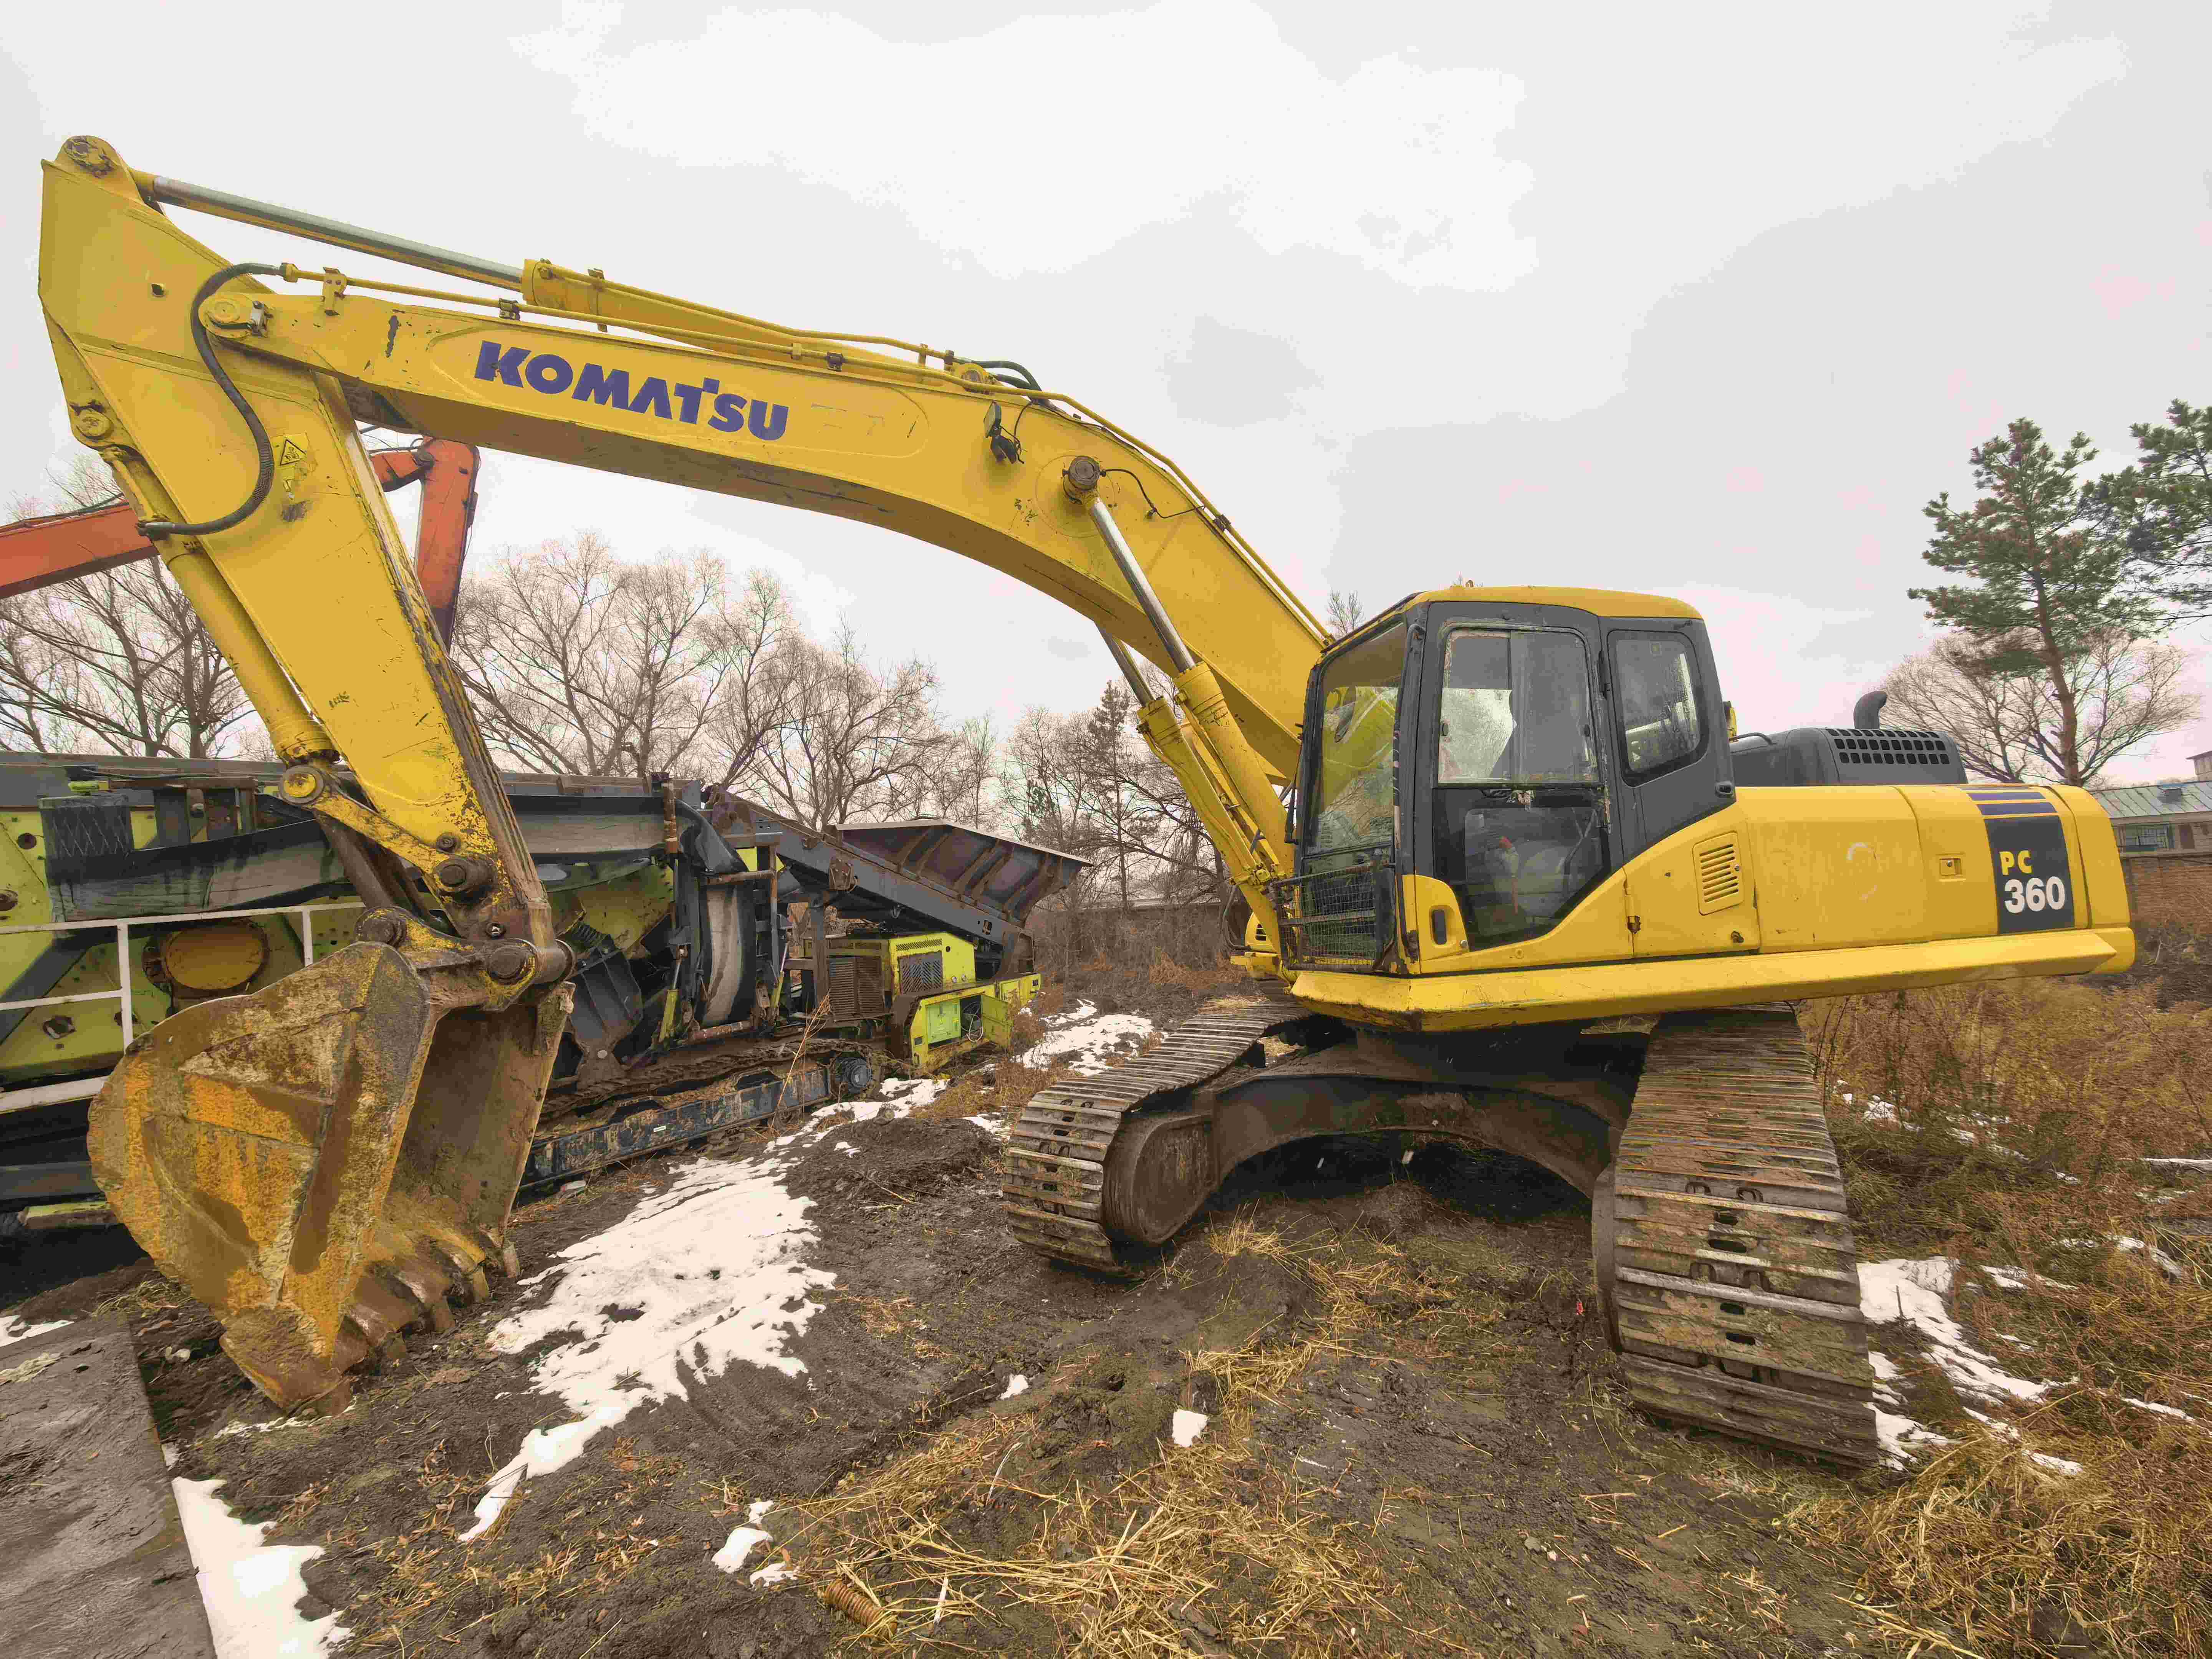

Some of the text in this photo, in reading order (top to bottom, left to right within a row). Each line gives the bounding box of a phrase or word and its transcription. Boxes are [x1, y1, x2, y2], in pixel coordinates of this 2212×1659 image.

[475, 340, 788, 440] KOMATSU
[1999, 850, 2032, 876] PC
[2004, 876, 2066, 914] 360
